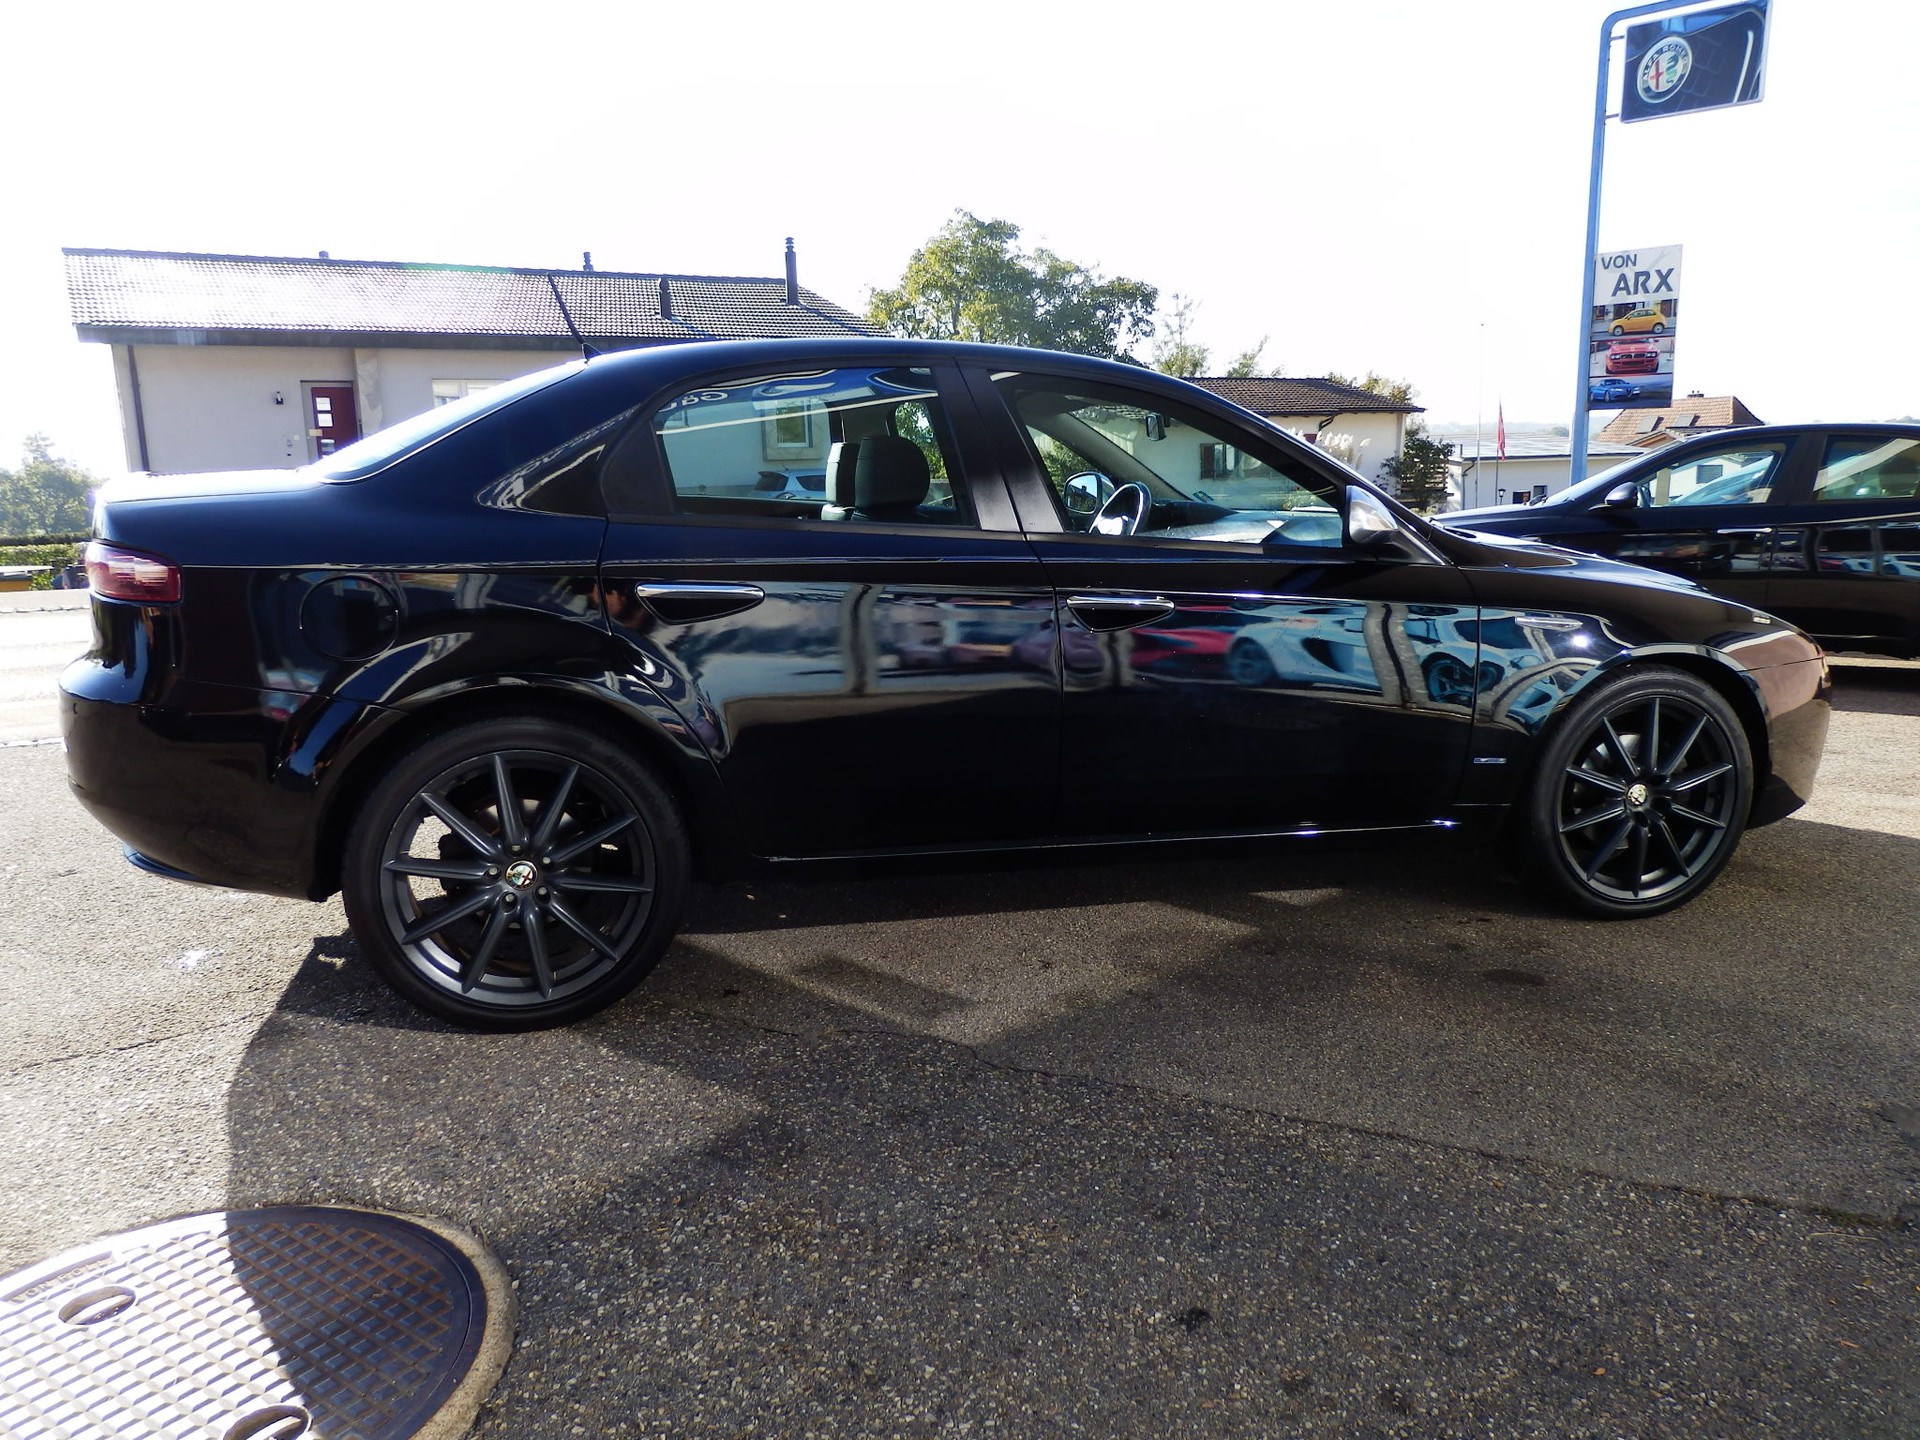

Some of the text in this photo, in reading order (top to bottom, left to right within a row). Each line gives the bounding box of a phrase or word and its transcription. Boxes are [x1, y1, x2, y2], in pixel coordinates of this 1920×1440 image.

[1642, 52, 1659, 80] ALFA
[1601, 253, 1638, 270] VON
[1611, 267, 1675, 297] ARX
